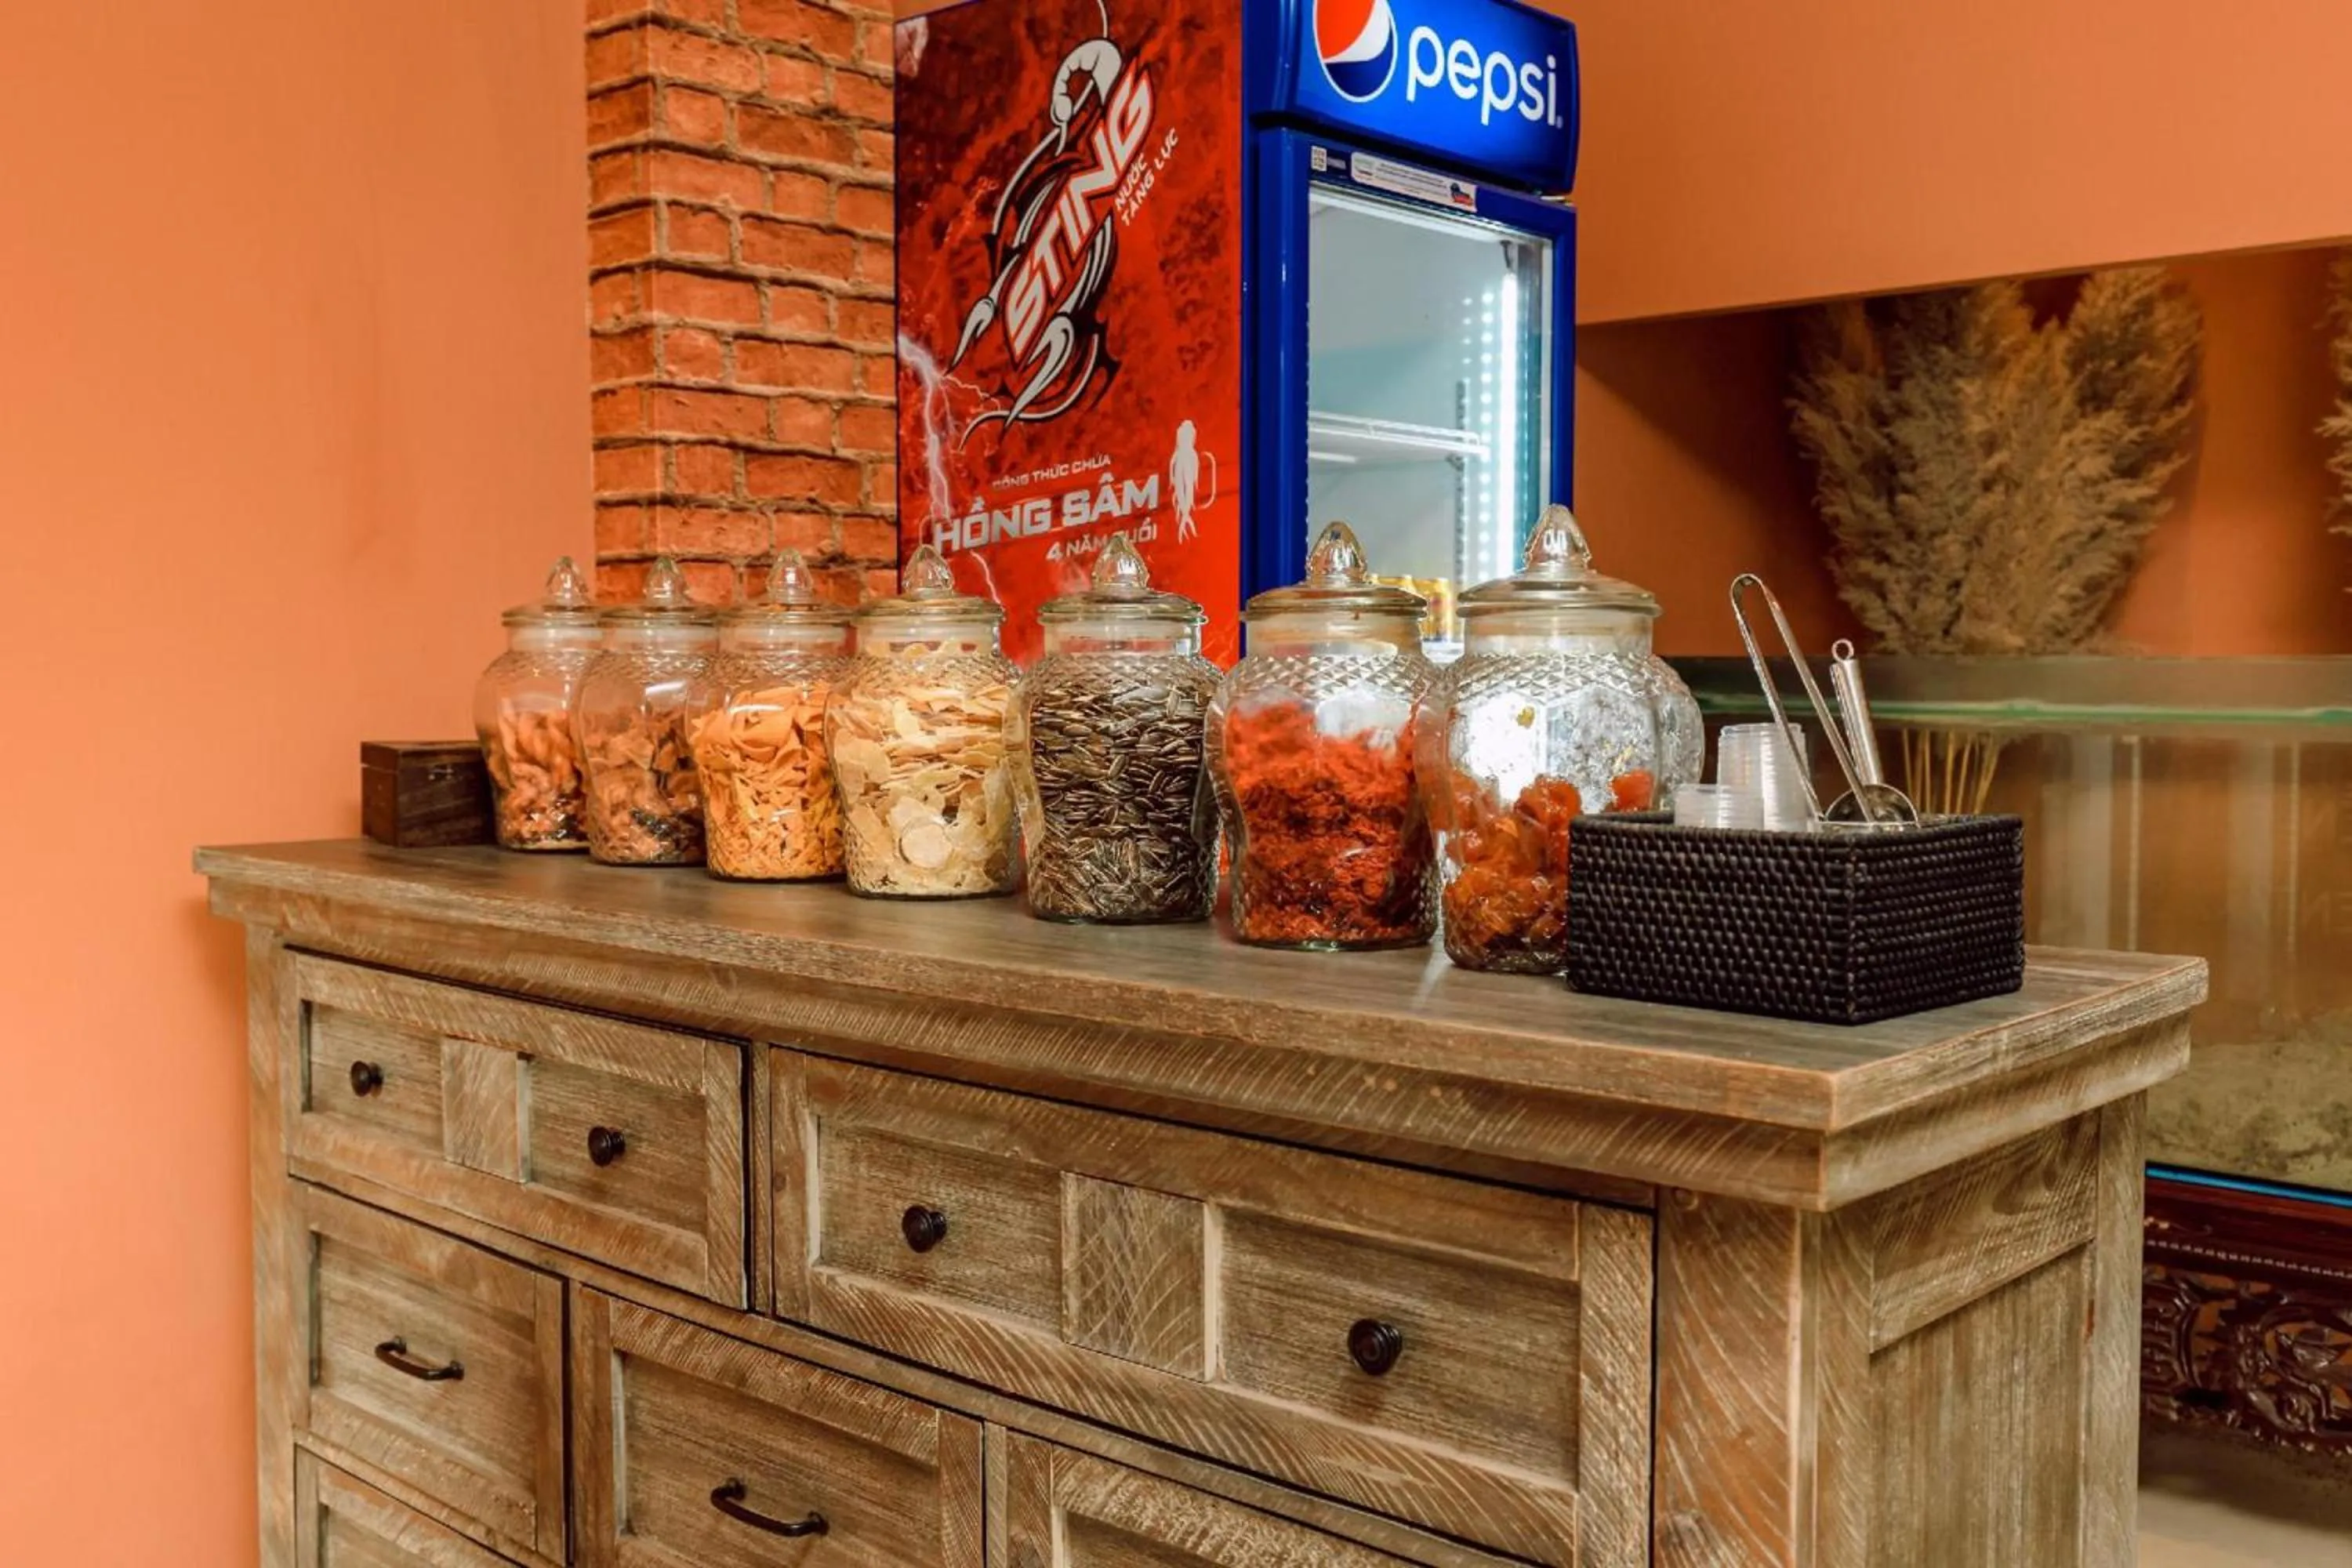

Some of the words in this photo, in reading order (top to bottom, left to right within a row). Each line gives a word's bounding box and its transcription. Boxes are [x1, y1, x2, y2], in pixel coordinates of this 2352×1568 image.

[1406, 25, 1558, 126] pepsi
[1005, 72, 1152, 364] STING
[1062, 472, 1160, 528] SÂM
[1046, 541, 1063, 560] 4
